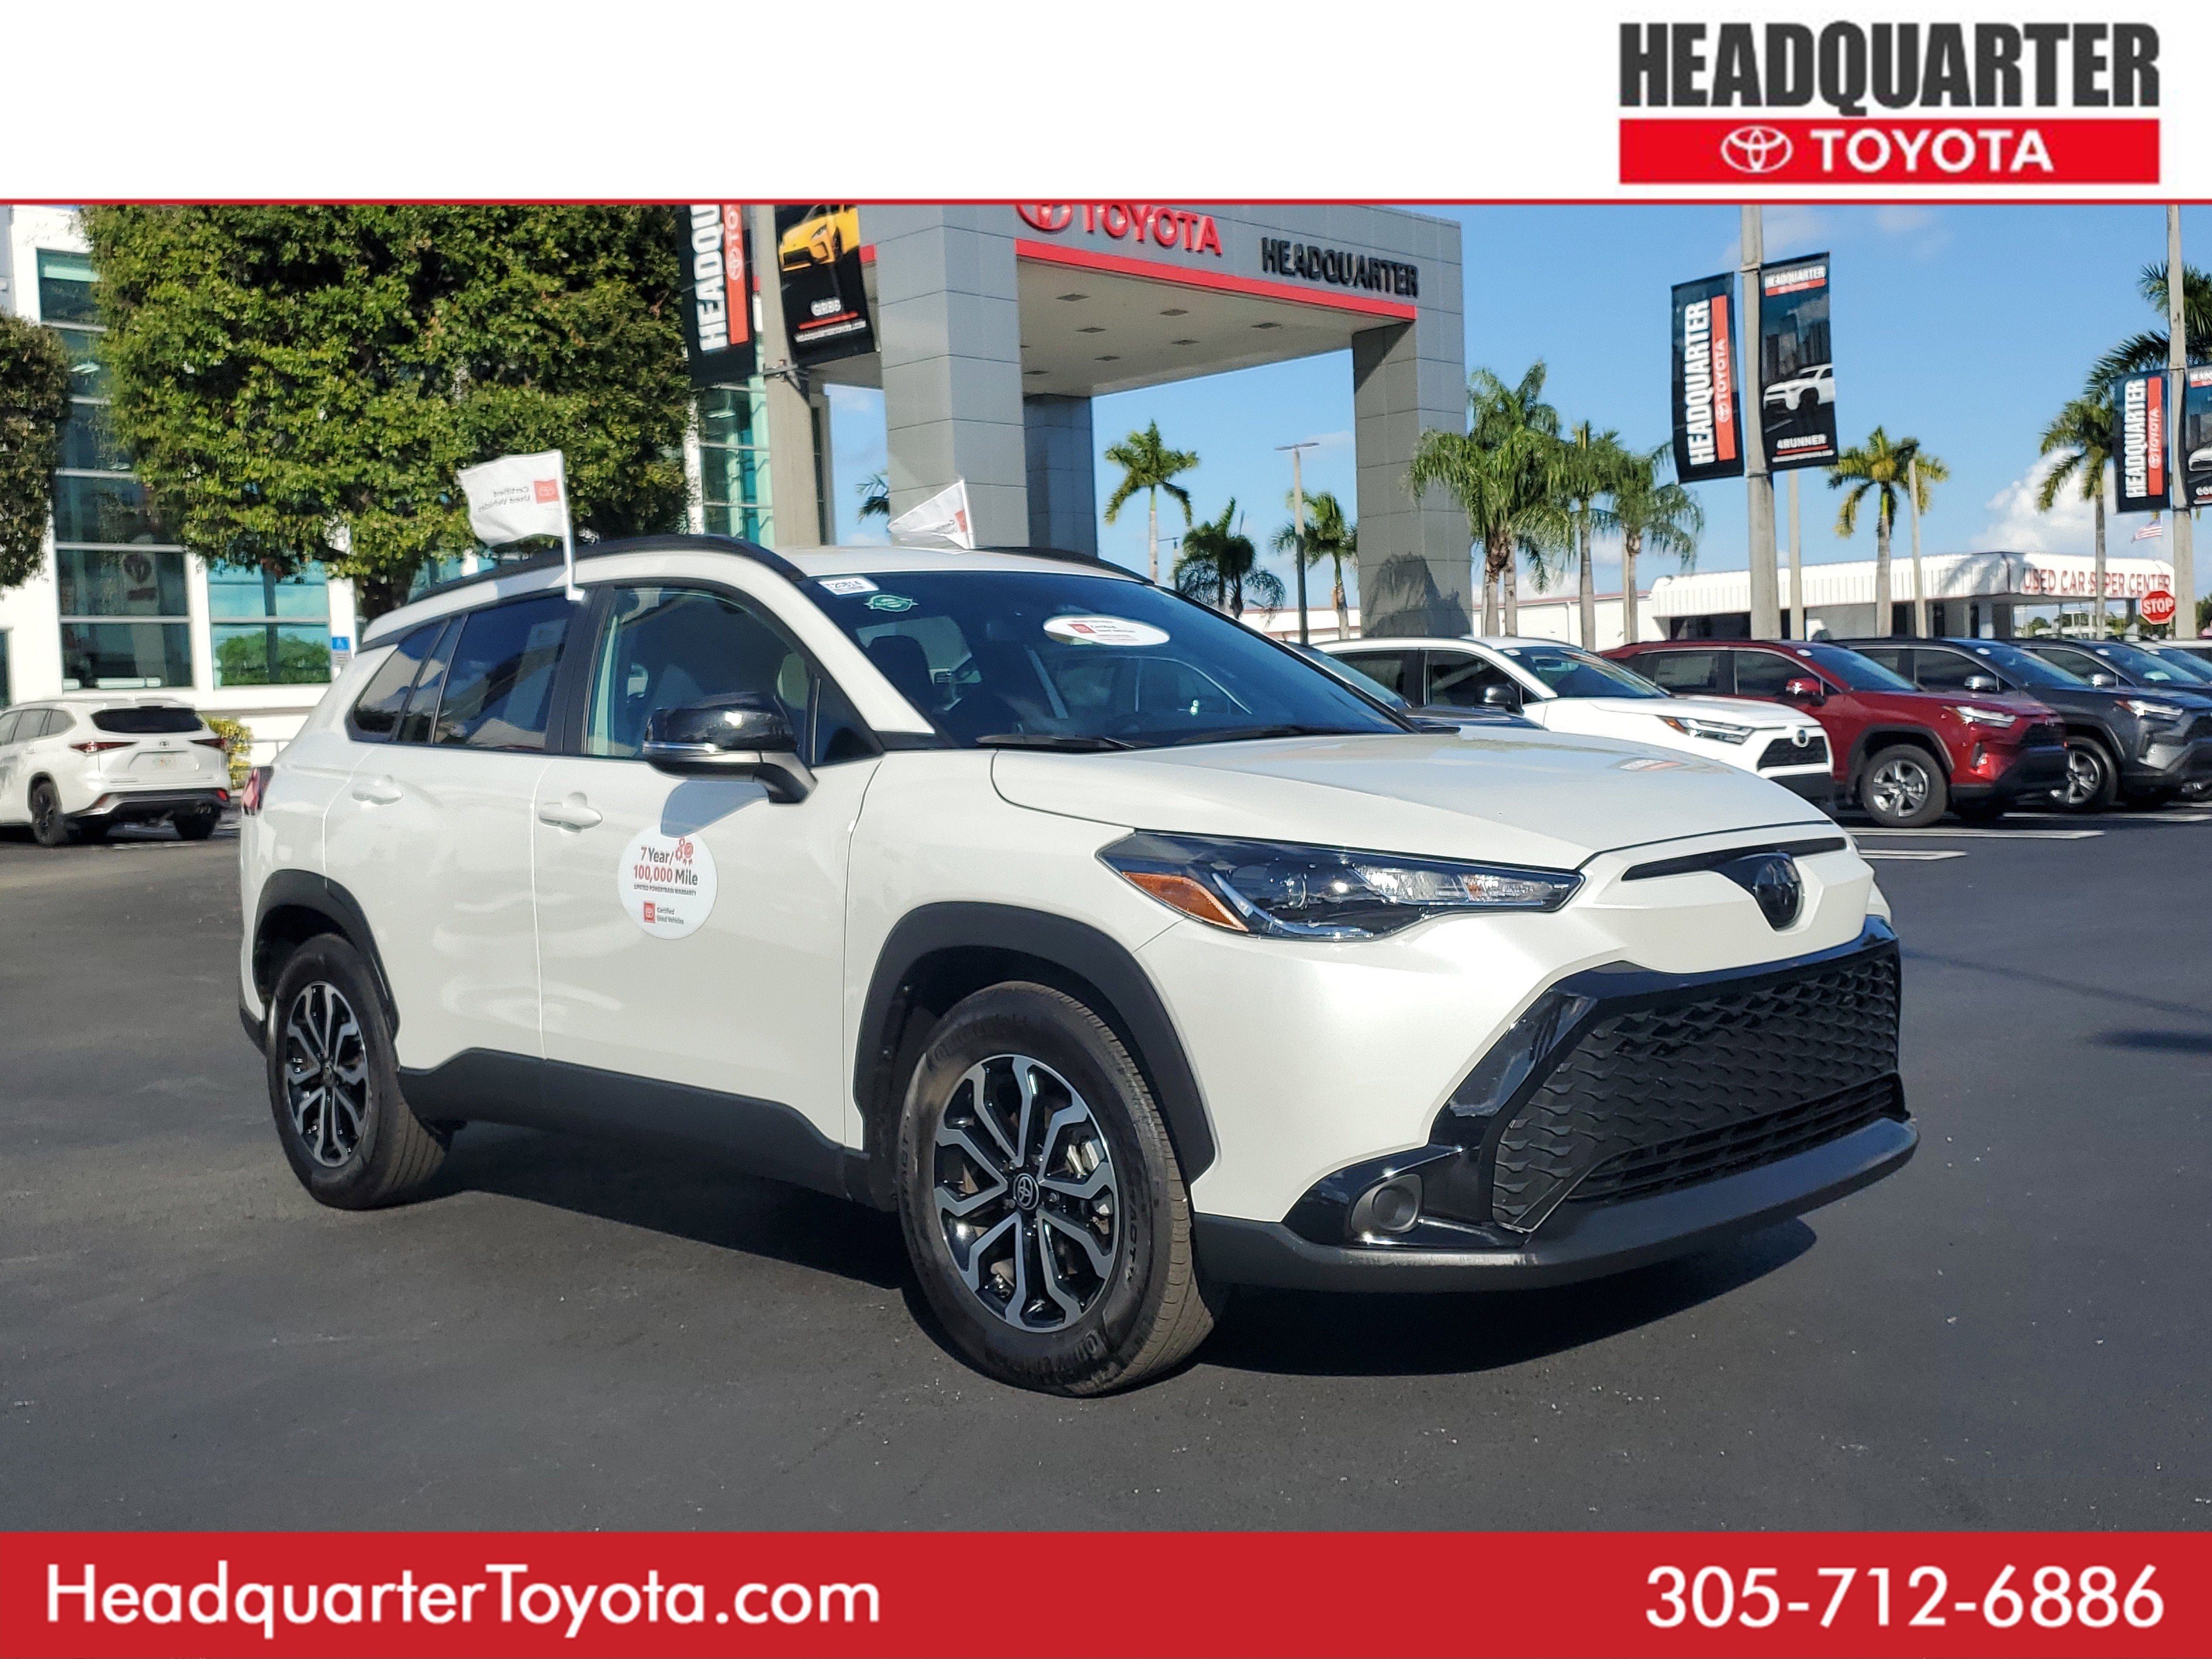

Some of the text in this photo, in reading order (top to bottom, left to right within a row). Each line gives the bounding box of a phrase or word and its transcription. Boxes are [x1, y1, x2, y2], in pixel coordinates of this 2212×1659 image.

[1083, 205, 1223, 256] TOYOTA
[1261, 237, 1420, 298] HEADQUARTER
[1765, 264, 1826, 289] HEADQUARTER
[1684, 299, 1716, 465] HEADQUARTER
[1713, 337, 1730, 402] TOYOTA
[2125, 378, 2147, 499] HEADQUARTER
[2148, 406, 2160, 453] TOYOTA
[2023, 568, 2171, 595] USED CAR SPER CENTER
[2142, 596, 2174, 615] STOP
[641, 846, 674, 866] 7 Year/
[634, 865, 698, 885] 100,000 Mile
[649, 885, 674, 894] POWERTRAIN
[675, 888, 697, 896] WARRANTY
